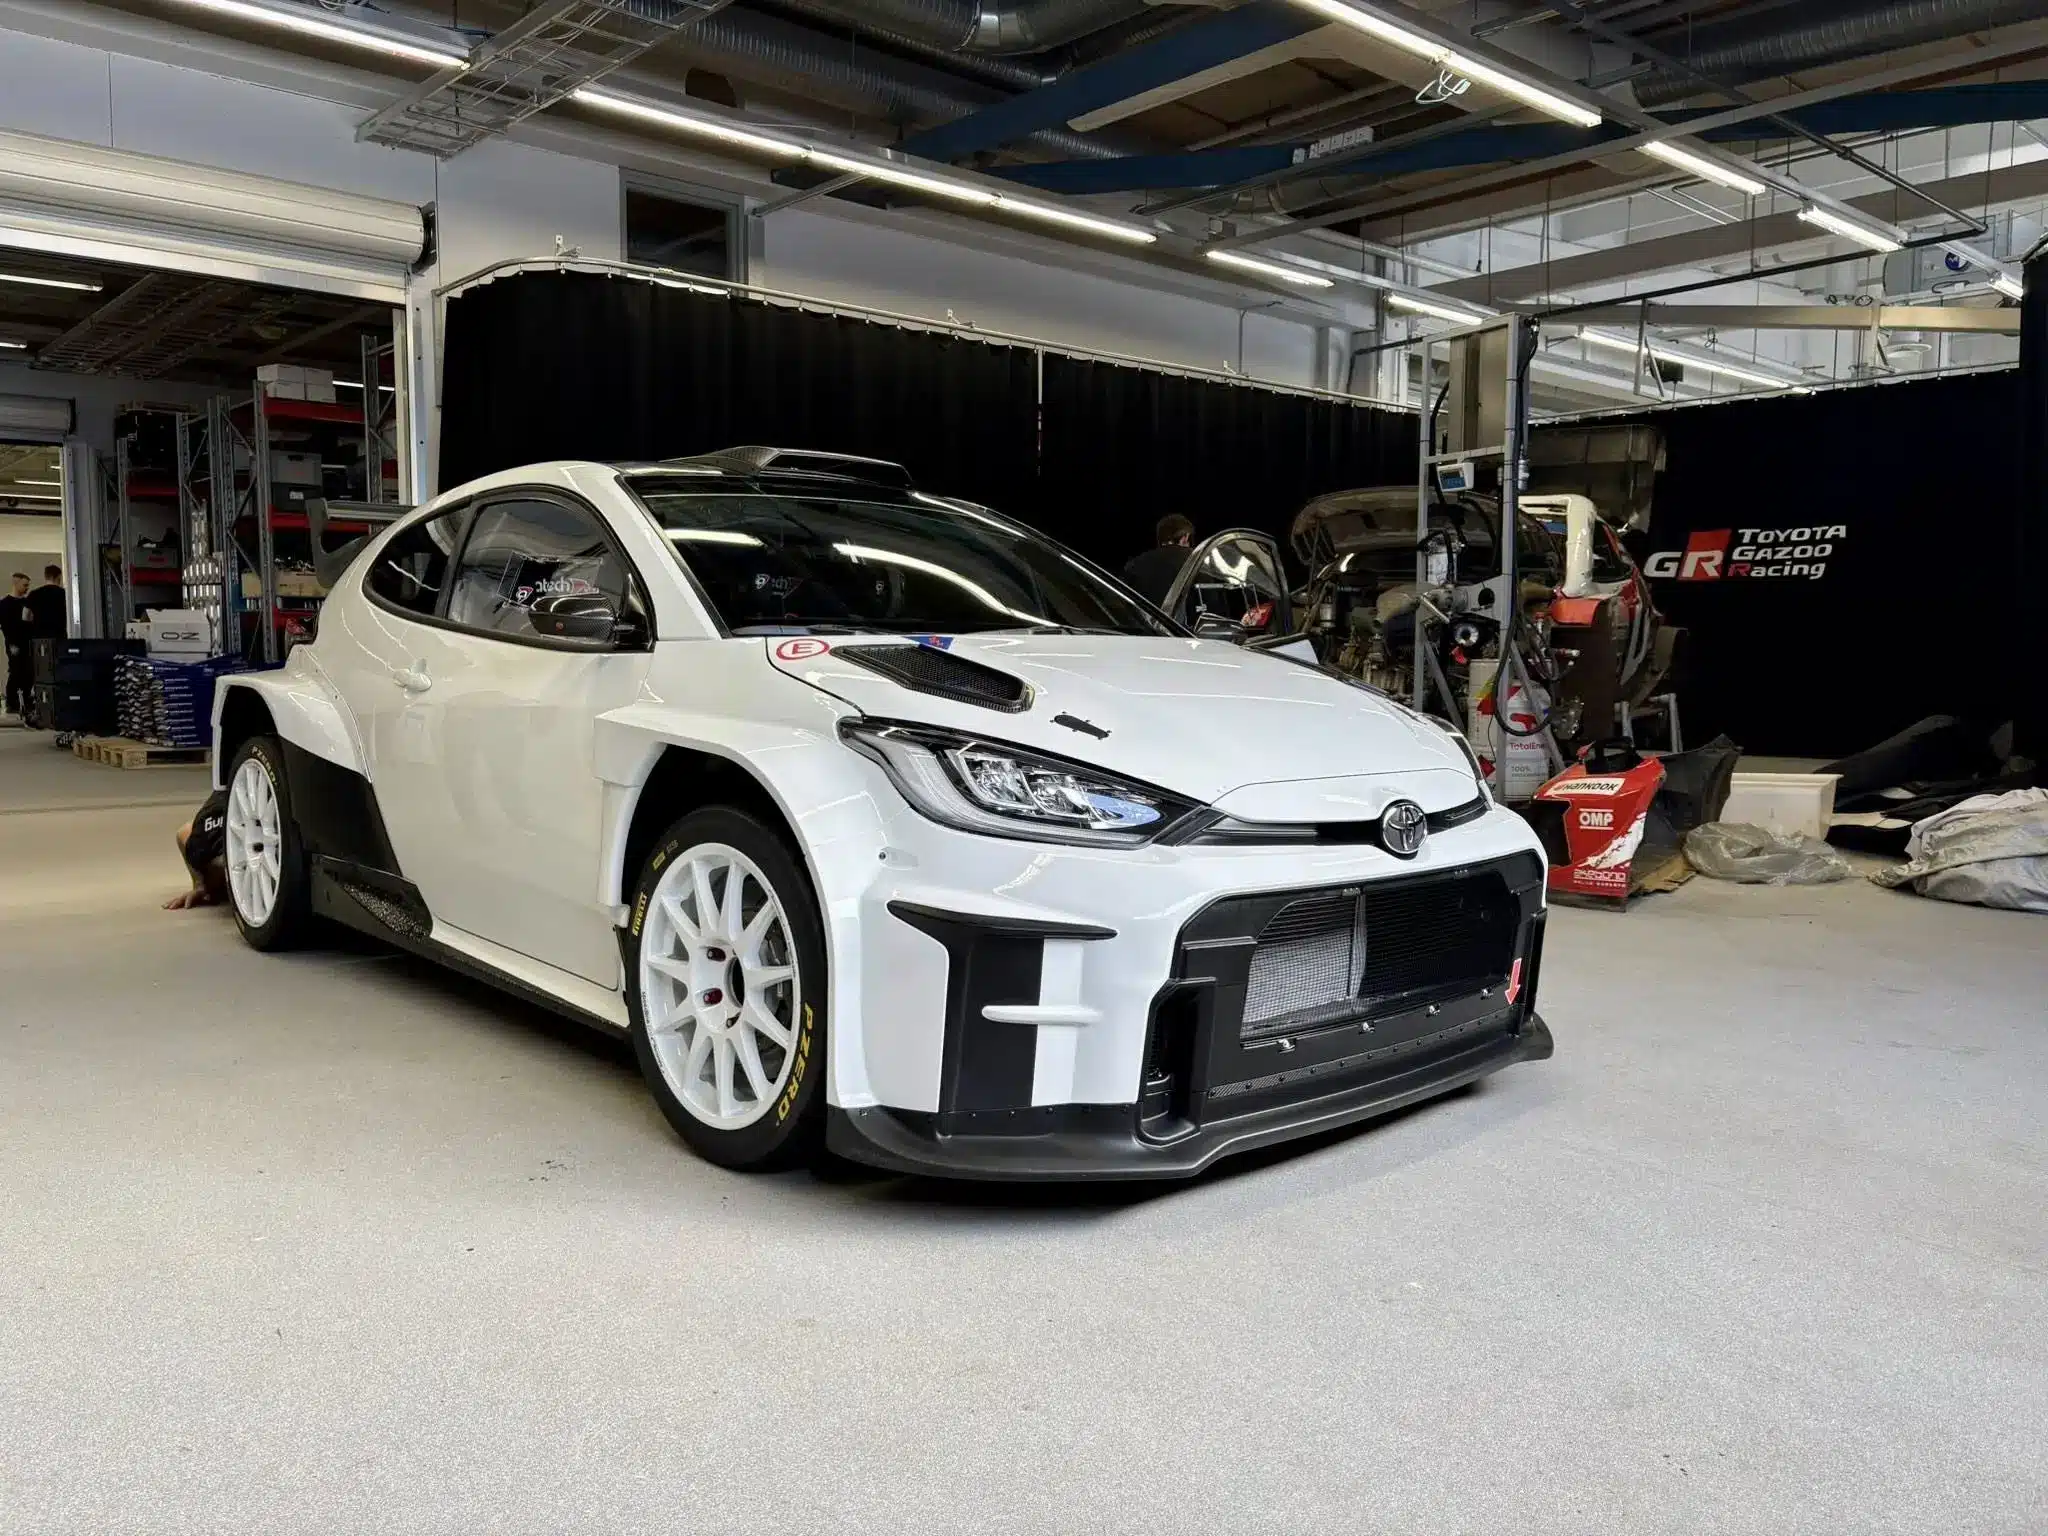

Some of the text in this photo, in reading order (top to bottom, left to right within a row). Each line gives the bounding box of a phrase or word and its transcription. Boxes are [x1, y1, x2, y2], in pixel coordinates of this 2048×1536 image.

[1738, 525, 1847, 544] TOYOTA
[1731, 543, 1833, 561] GAZOO
[1643, 549, 1724, 578] GR
[1727, 561, 1826, 580] Racing
[1579, 812, 1614, 827] OMP
